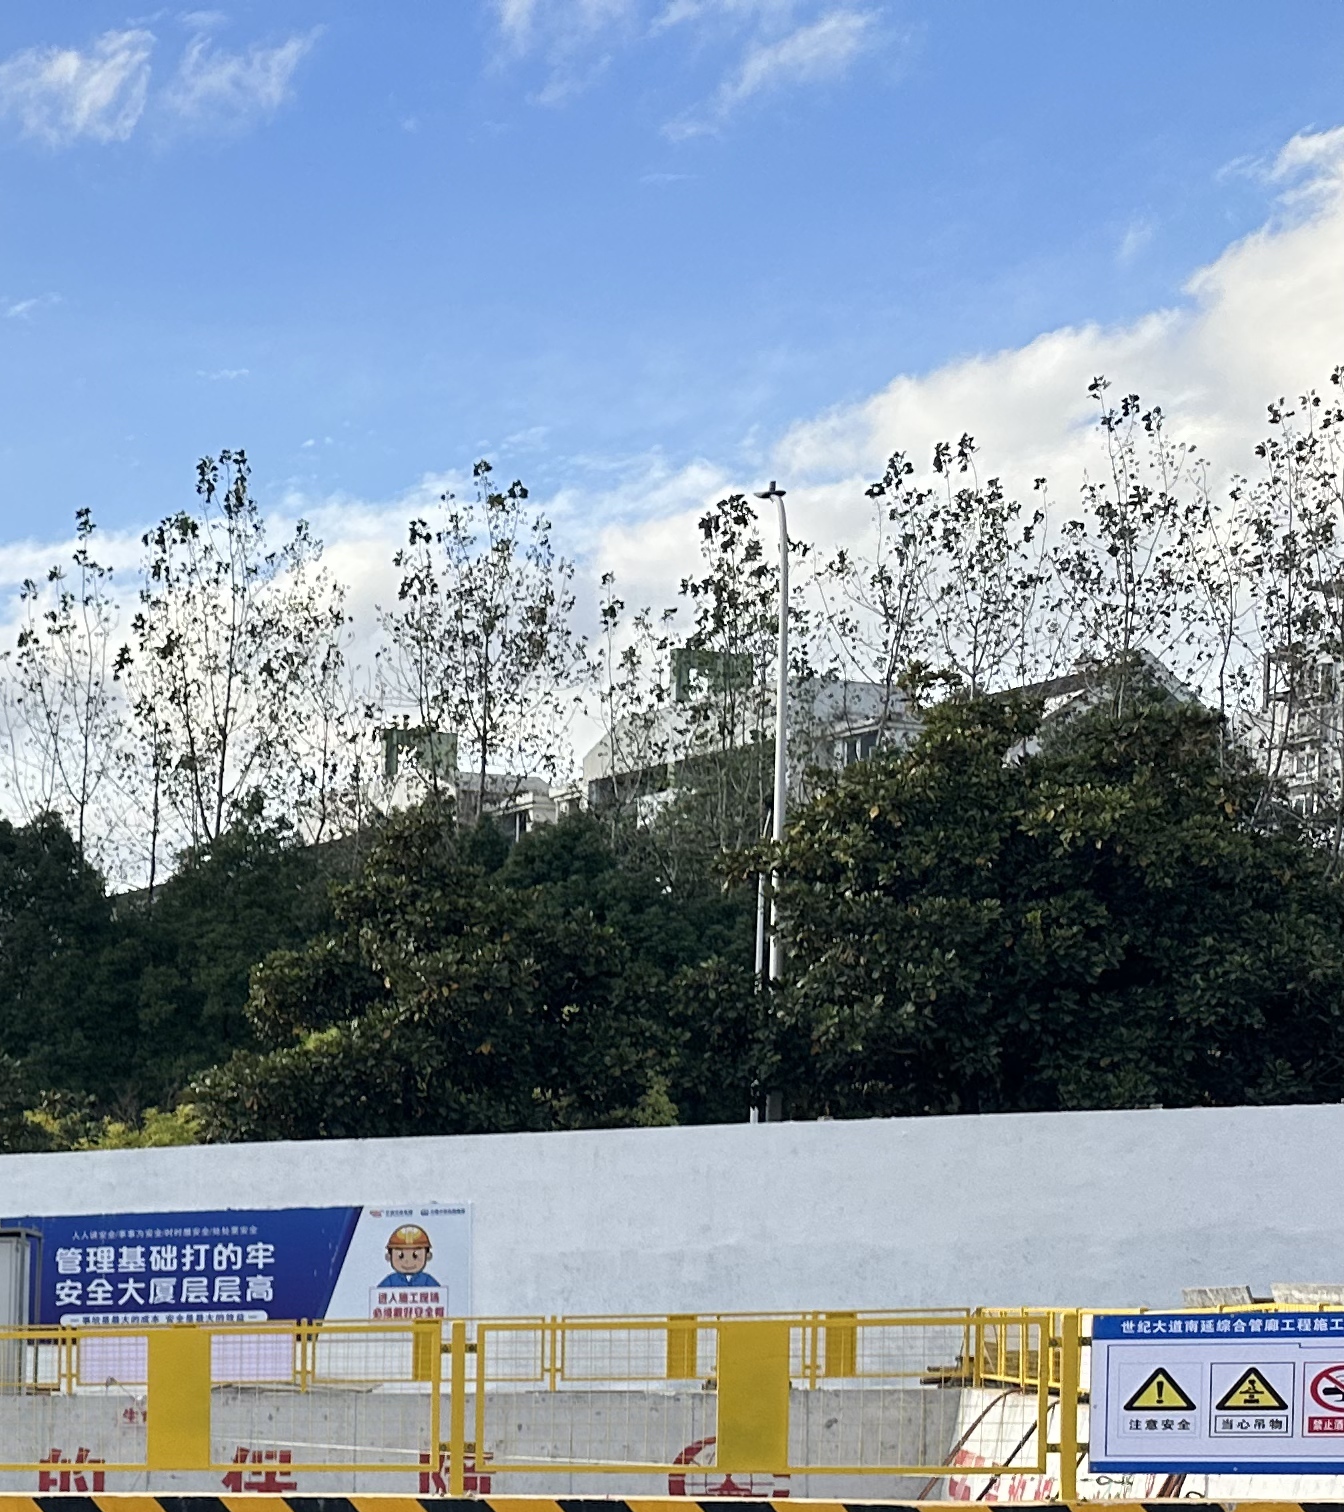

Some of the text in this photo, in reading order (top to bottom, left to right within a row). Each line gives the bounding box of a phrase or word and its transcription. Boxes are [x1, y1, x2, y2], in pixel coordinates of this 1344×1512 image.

[55, 1242, 275, 1274] 管理基础打的牢
[55, 1274, 274, 1306] 安全大厦层层高
[1129, 1418, 1191, 1431] 注意安全
[1222, 1418, 1283, 1431] 当心吊物
